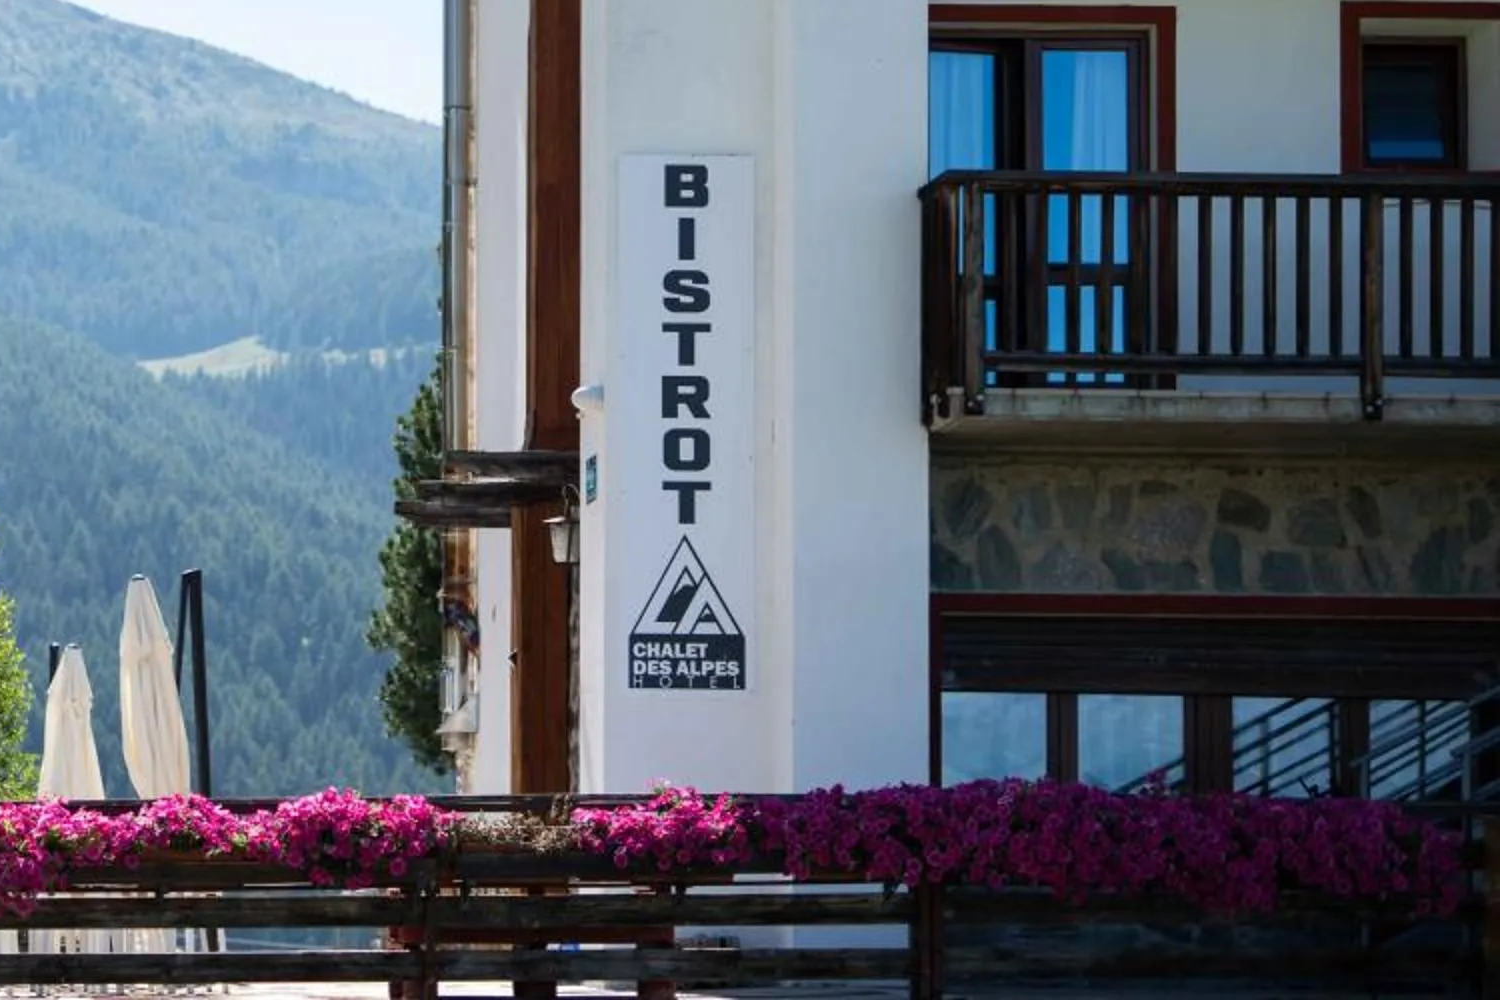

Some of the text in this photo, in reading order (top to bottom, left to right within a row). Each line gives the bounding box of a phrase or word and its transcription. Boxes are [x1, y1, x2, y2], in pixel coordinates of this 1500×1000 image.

[661, 164, 712, 524] BISTROT
[633, 643, 708, 658] CHALET
[633, 660, 740, 676] DES ALPES
[633, 676, 740, 688] HOTEL
